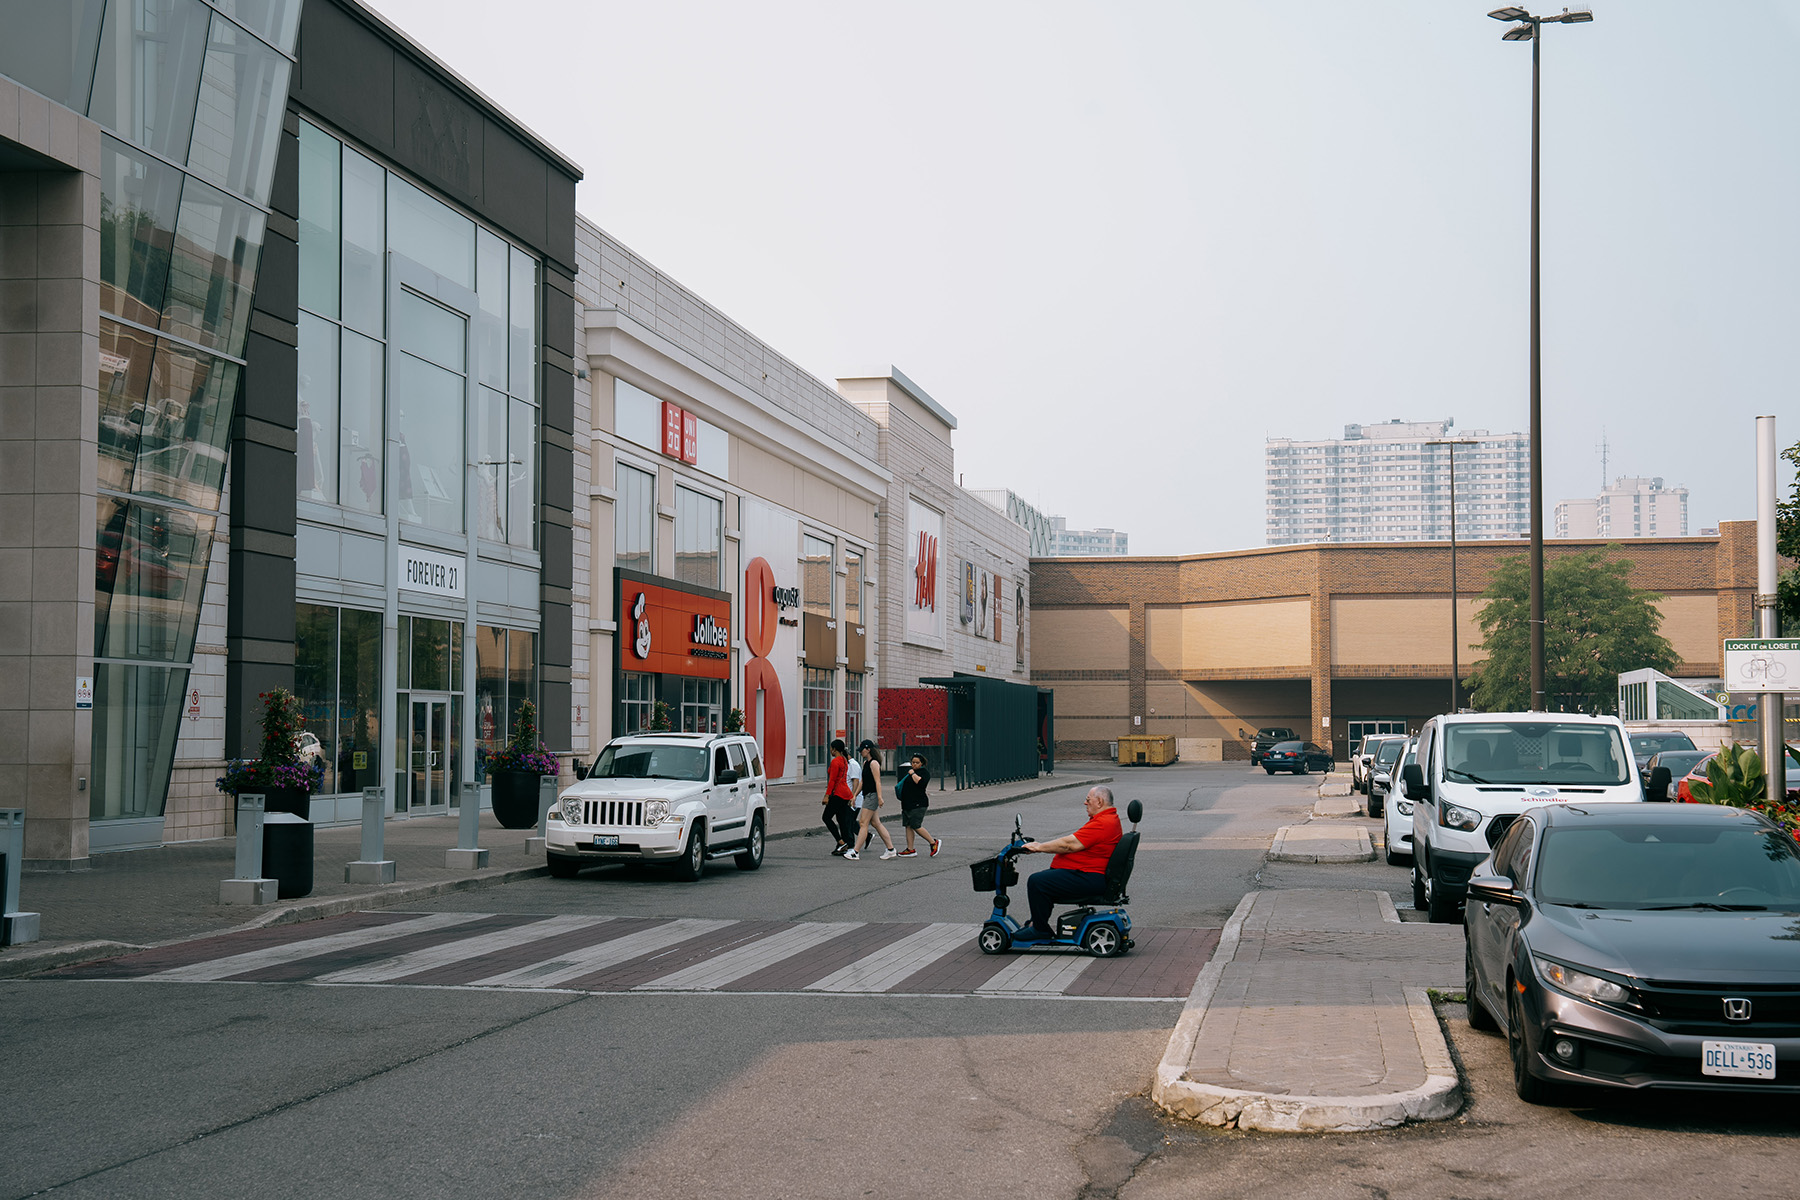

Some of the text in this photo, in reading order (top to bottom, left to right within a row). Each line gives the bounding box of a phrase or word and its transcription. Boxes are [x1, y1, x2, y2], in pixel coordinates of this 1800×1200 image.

[685, 416, 695, 438] UNI
[685, 438, 696, 459] QLO
[407, 559, 458, 590] FOREVER 21
[915, 531, 937, 613] H&M
[692, 614, 728, 648] Jollibee
[1706, 1050, 1773, 1070] DELL 536
